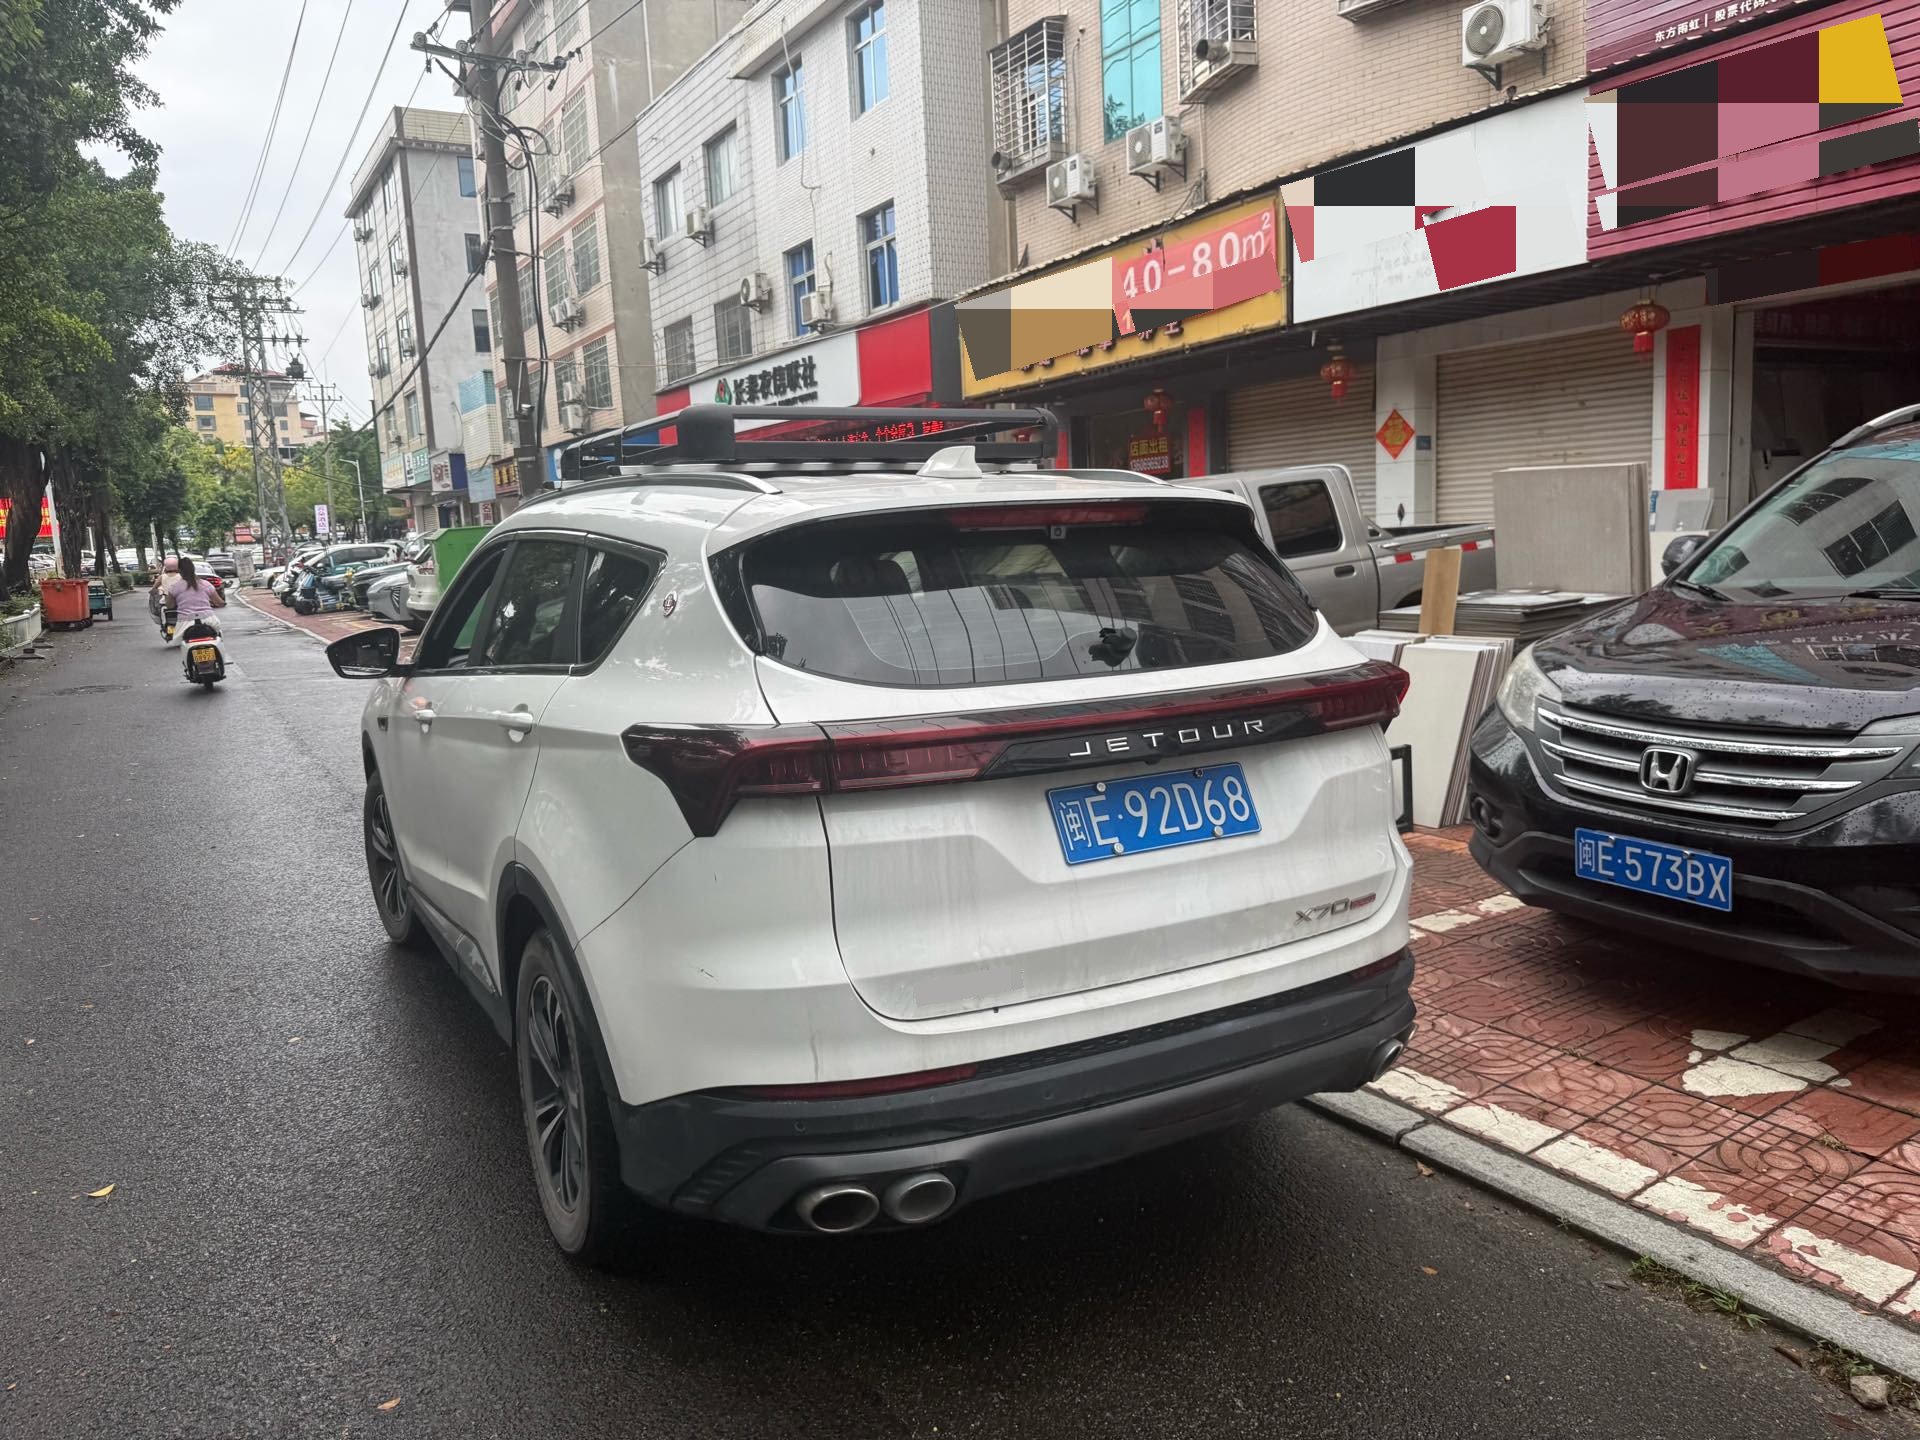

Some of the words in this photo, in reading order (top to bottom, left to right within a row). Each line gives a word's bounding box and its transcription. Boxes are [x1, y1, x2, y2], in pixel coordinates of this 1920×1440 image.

[1655, 17, 1700, 43] 东方雨虹
[1130, 437, 1168, 456] 店面出租
[1069, 719, 1265, 757] JETOUR
